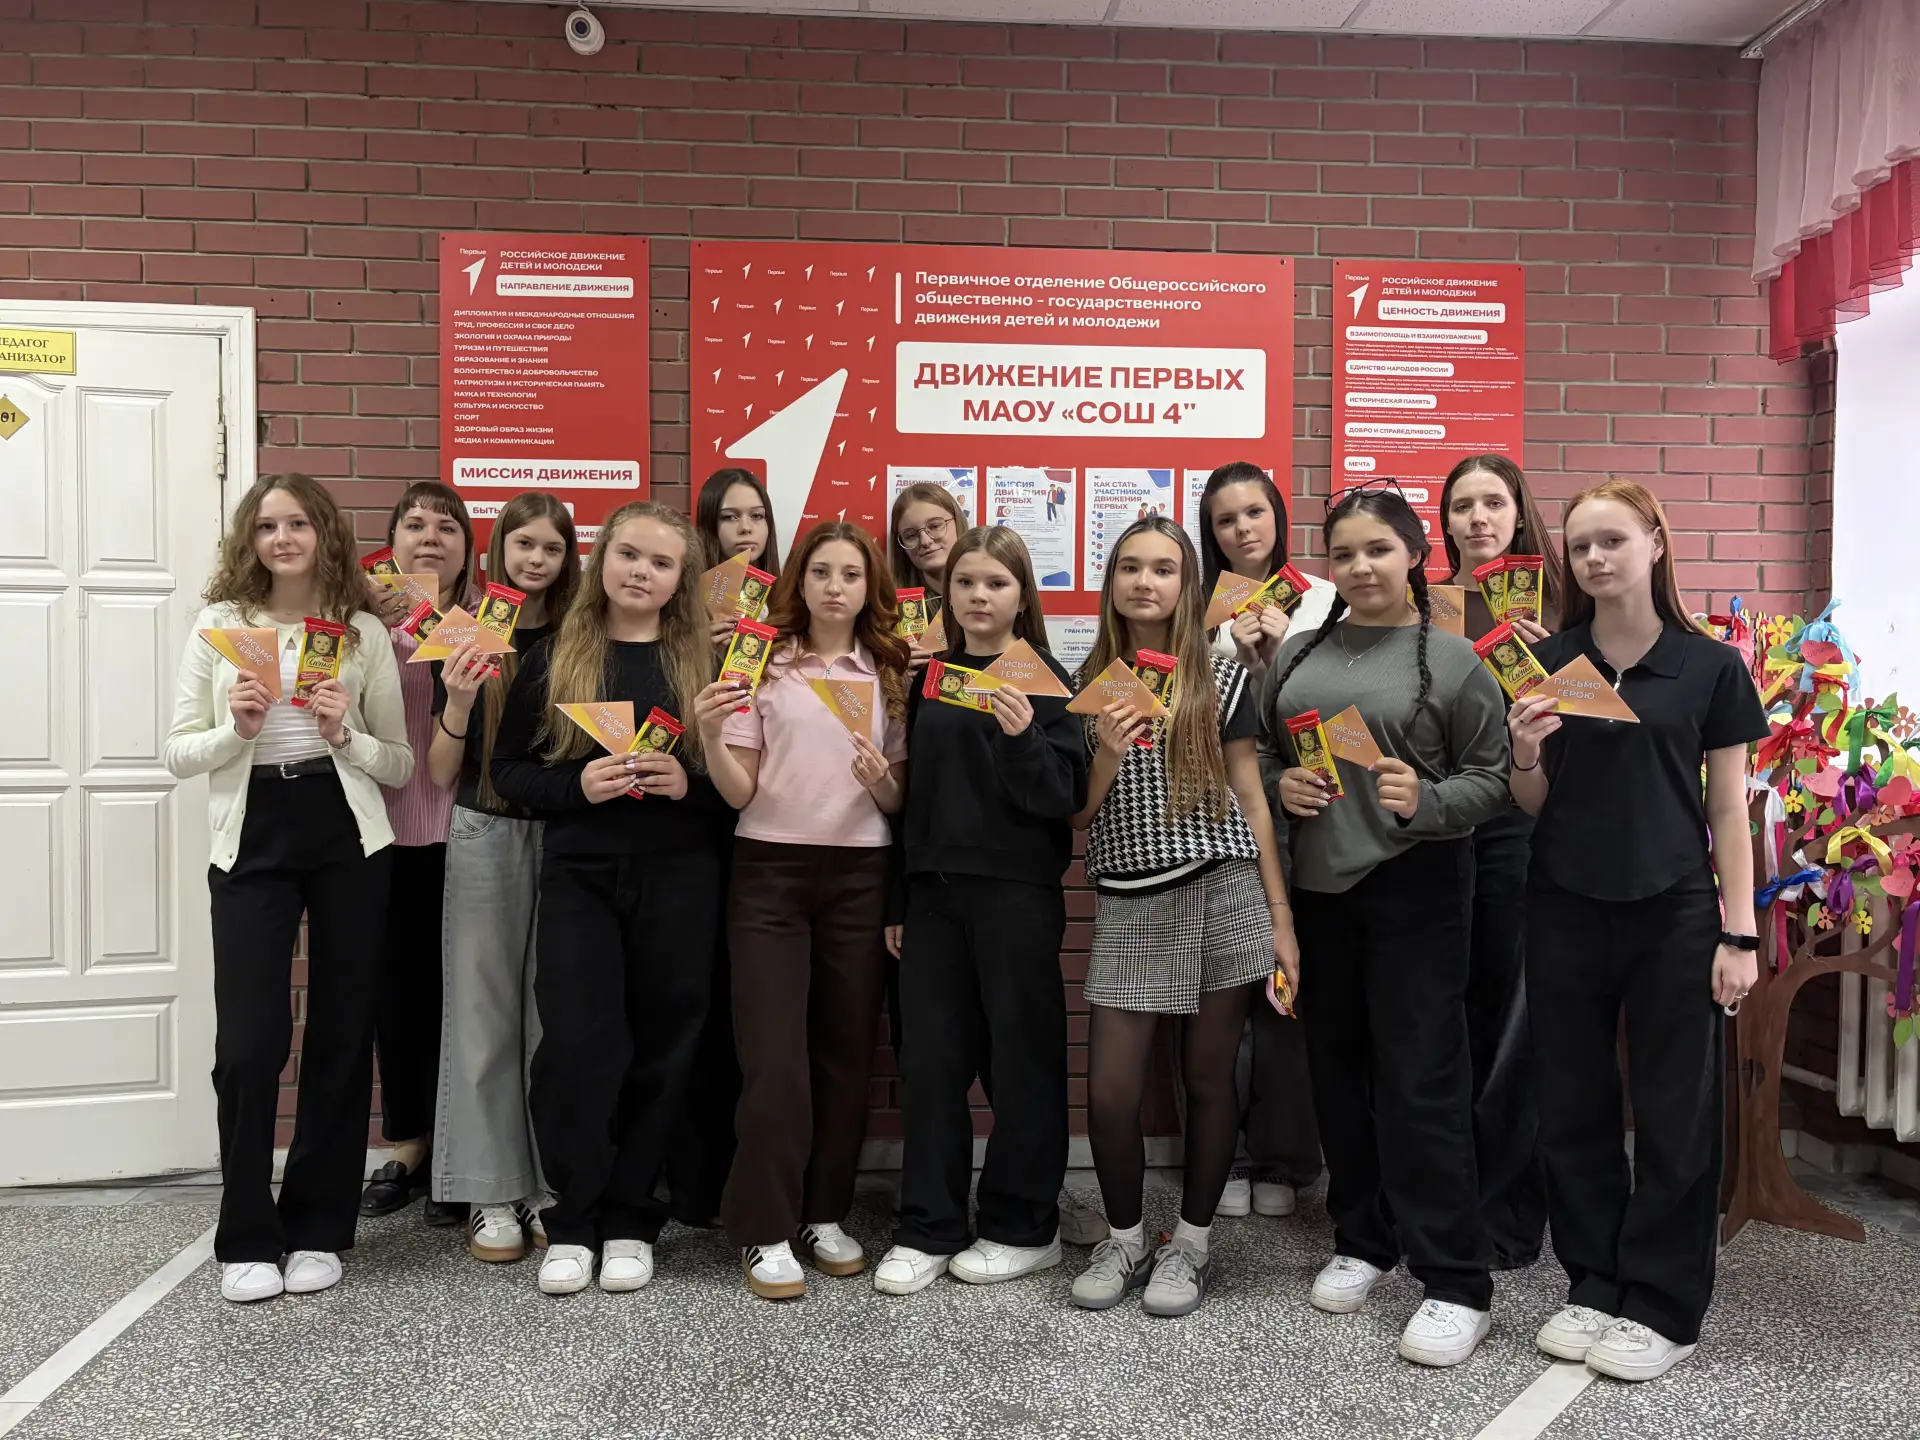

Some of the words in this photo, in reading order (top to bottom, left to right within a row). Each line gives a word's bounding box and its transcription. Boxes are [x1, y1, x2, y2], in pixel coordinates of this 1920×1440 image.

[500, 250, 567, 260] РОССИЙСКОЕ
[569, 252, 625, 260] ДВИЖЕНИЕ
[500, 261, 532, 270] ДЕТЕЙ
[544, 263, 602, 271] МОЛОДЕЖИ
[500, 282, 571, 291] НАПРАВЛЕНИЕ
[573, 284, 629, 292] ДВИЖЕНИЯ
[915, 271, 1010, 289] Первичное
[1015, 276, 1105, 290] отделение
[1109, 277, 1266, 294] Общероссийского
[1382, 277, 1444, 285] РОССИЙСКОЕ
[1446, 279, 1498, 287] ДВИЖЕНИЕ
[1382, 287, 1412, 295] ДЕТЕЙ
[1422, 289, 1476, 297] МОЛОДЕЖИ
[915, 292, 1033, 307] общественно
[1048, 296, 1201, 312] государственного
[515, 311, 585, 319] МЕЖДУНАРОДНЫЕ
[1383, 307, 1438, 316] ЦЕННОСТЬ
[1440, 309, 1500, 317] ДВИЖЕНИЯ
[915, 312, 1001, 327] движения
[1004, 313, 1053, 328] детей
[1058, 317, 1068, 326] и
[1072, 316, 1160, 330] молодежи
[914, 363, 1103, 389] ДВИЖЕНИЕ
[1110, 367, 1244, 391] ПЕРВЫХ
[963, 400, 1054, 423] МАОУ
[1061, 401, 1154, 424] «СОШ
[454, 425, 498, 433] ЗДОРОВЫЙ
[461, 468, 533, 479] МИССИЯ
[537, 469, 632, 481] ДВИЖЕНИЯ
[403, 586, 423, 602] ГЕРО
[406, 576, 435, 602] ПИСЬМО
[716, 576, 728, 604] ГЕРОЮ
[1216, 582, 1248, 600] ПИСЬМО
[1223, 591, 1249, 606] ГЕРОЮ
[1430, 588, 1457, 617] ПИСЬМО
[439, 626, 478, 635] ПИСЬМО
[240, 632, 274, 662] ПИСЬМО
[444, 636, 475, 644] ГЕРОЮ
[236, 642, 264, 666] ГЕРОЮ
[999, 660, 1037, 669] ПИСЬМО
[1001, 671, 1033, 679] ГЕРОЮ
[1099, 680, 1137, 688] ПИСЬМО
[1555, 677, 1600, 690] ПИСЬМО
[840, 684, 867, 715] ПИСЬМО
[1557, 689, 1594, 700] ГЕРОЮ
[836, 693, 858, 718] ГЕРОЮ
[596, 716, 621, 738] ГЕРОЮ
[600, 707, 630, 735] ПИСЬМО
[1332, 723, 1367, 740] ПИСЬМО
[1332, 733, 1360, 748] ГЕРОЮ
